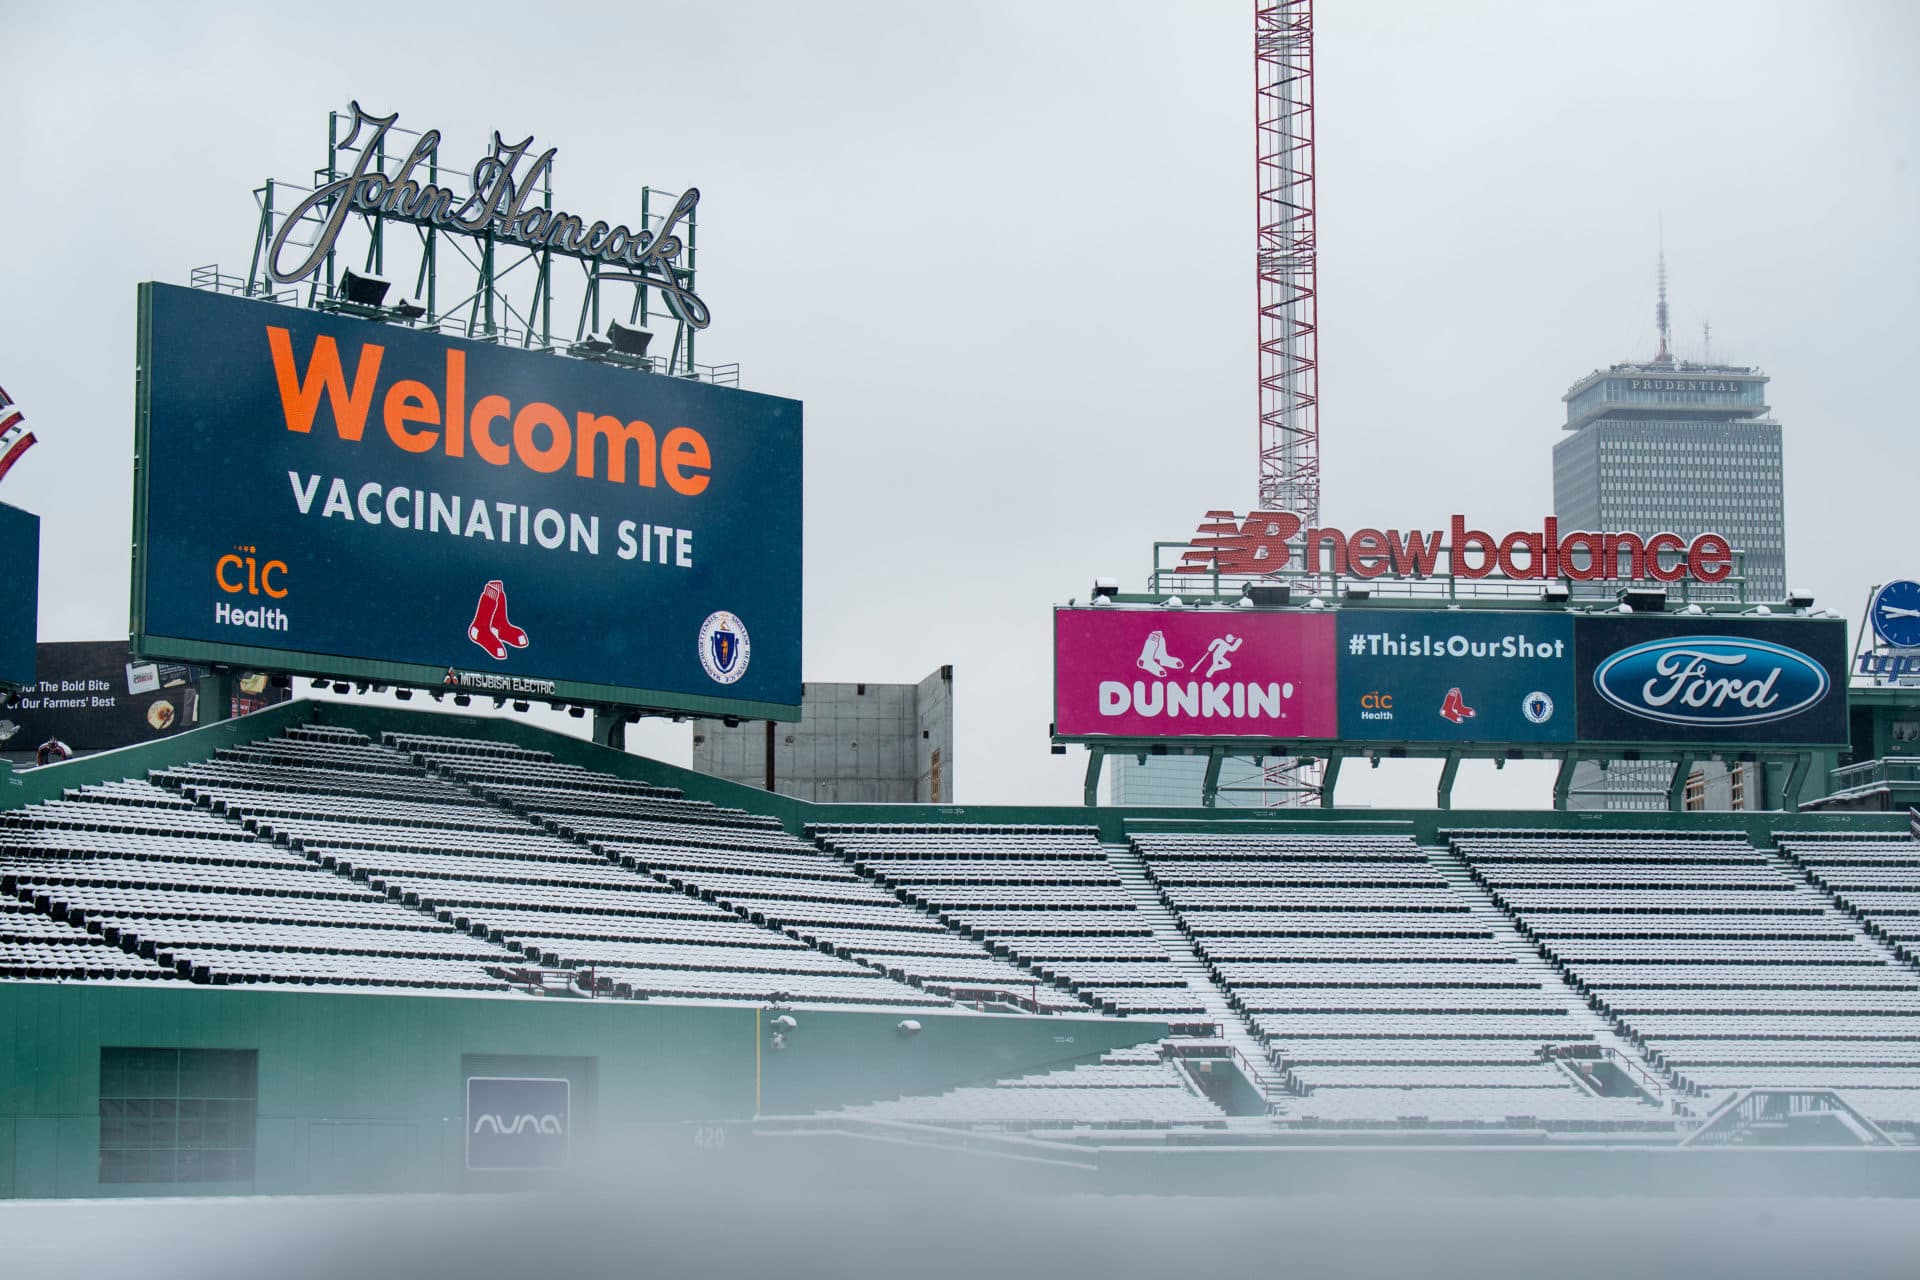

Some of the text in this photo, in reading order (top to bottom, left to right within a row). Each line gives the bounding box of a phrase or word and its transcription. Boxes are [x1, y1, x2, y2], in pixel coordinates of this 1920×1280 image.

[266, 100, 711, 329] John Hancock
[1631, 379, 1738, 392] PRUDENTIAL
[266, 324, 712, 496] Welcome
[288, 471, 693, 568] VACCINATION SITE
[215, 545, 289, 599] cic
[215, 601, 289, 632] Health
[1349, 632, 1565, 658] #ThisIsOurShot
[39, 681, 59, 692] The
[61, 680, 86, 692] Bold
[88, 679, 110, 691] Bite
[459, 672, 556, 695] MITSUBISHI ELECTRIC
[1642, 649, 1782, 709] Ford
[22, 698, 40, 709] Our
[43, 696, 89, 709] Farmers'
[91, 696, 116, 707] Best
[1099, 681, 1294, 718] DUNKIN'
[1360, 690, 1393, 709] cic
[1361, 711, 1393, 720] Health
[694, 1126, 725, 1147] 420
